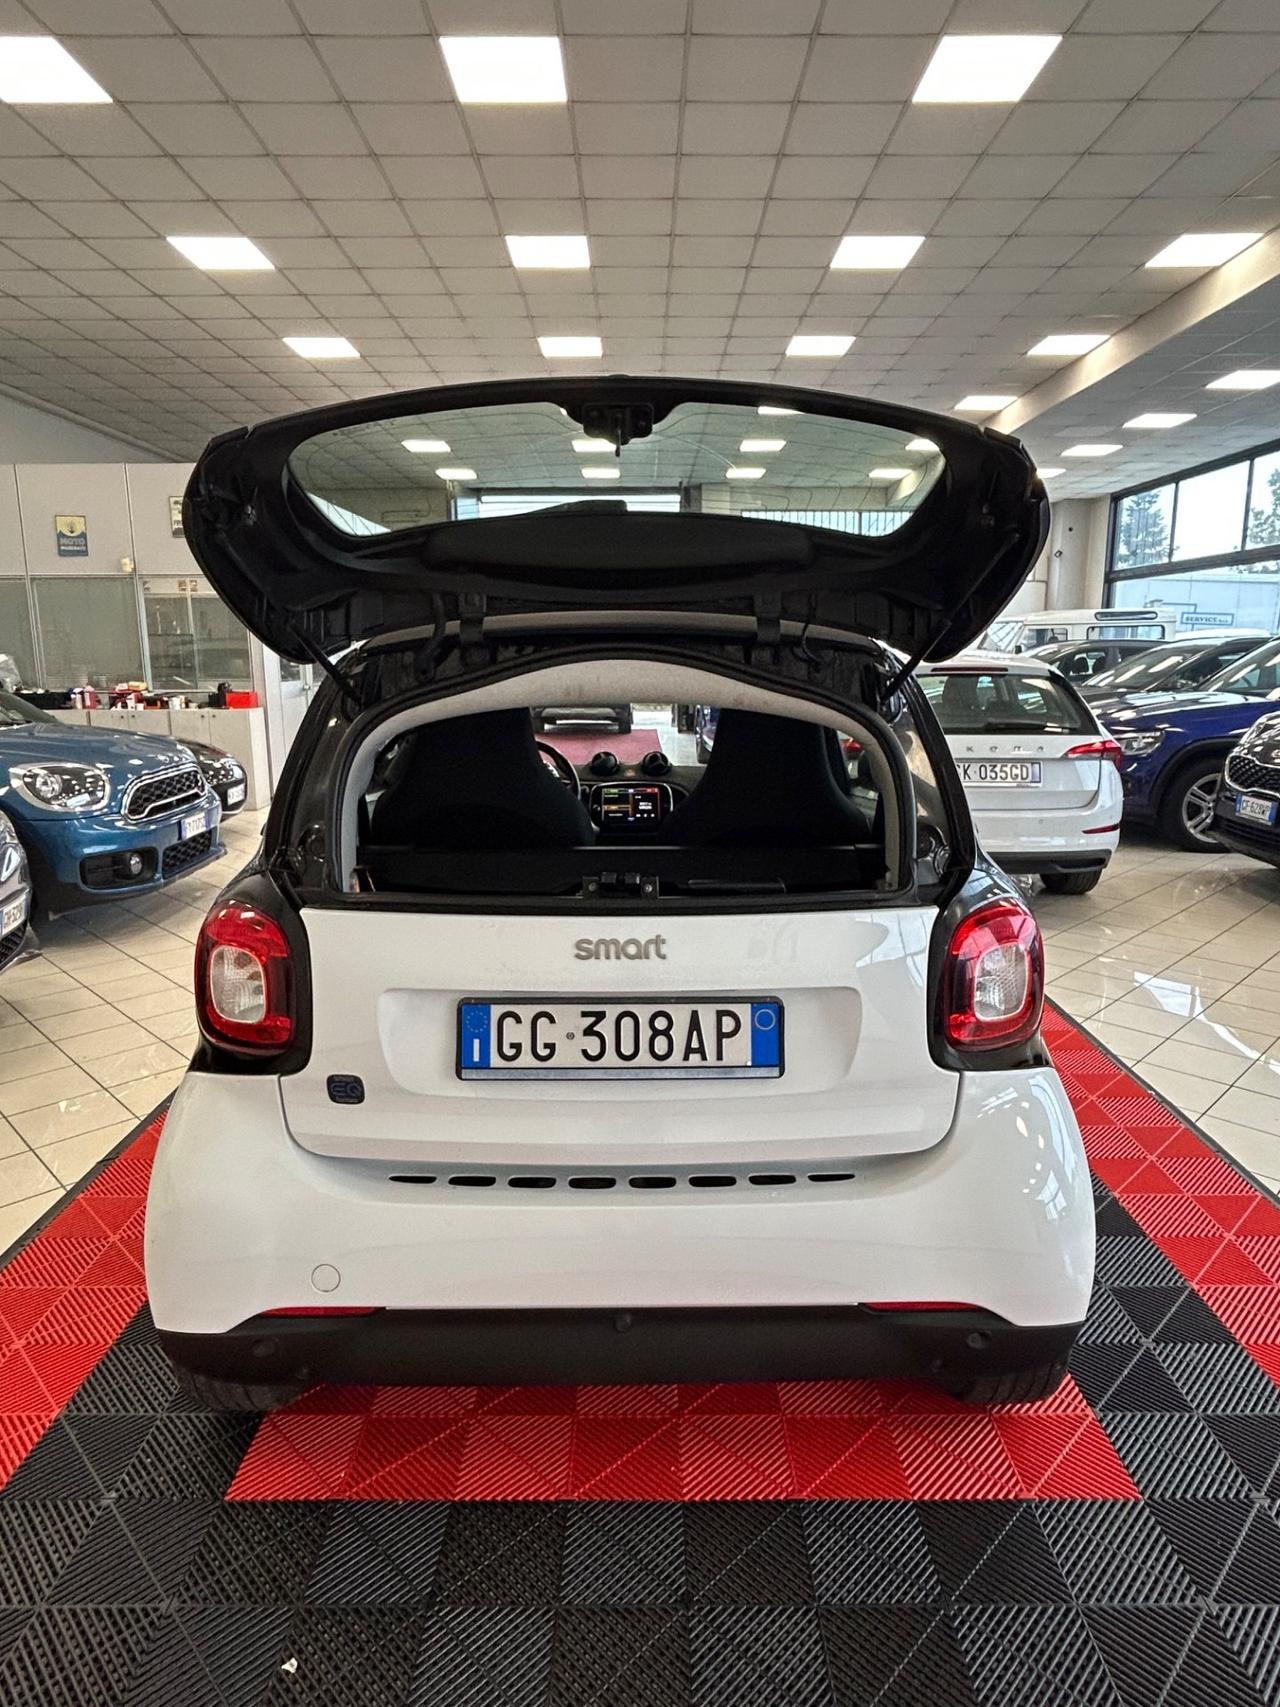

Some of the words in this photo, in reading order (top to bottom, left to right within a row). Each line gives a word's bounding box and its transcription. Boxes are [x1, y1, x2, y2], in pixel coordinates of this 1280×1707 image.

[956, 763, 972, 781] K
[978, 763, 1030, 781] 035GD
[574, 934, 667, 961] smart
[496, 1010, 557, 1062] GG
[580, 1009, 742, 1062] 308AP
[330, 1082, 363, 1097] EQ
